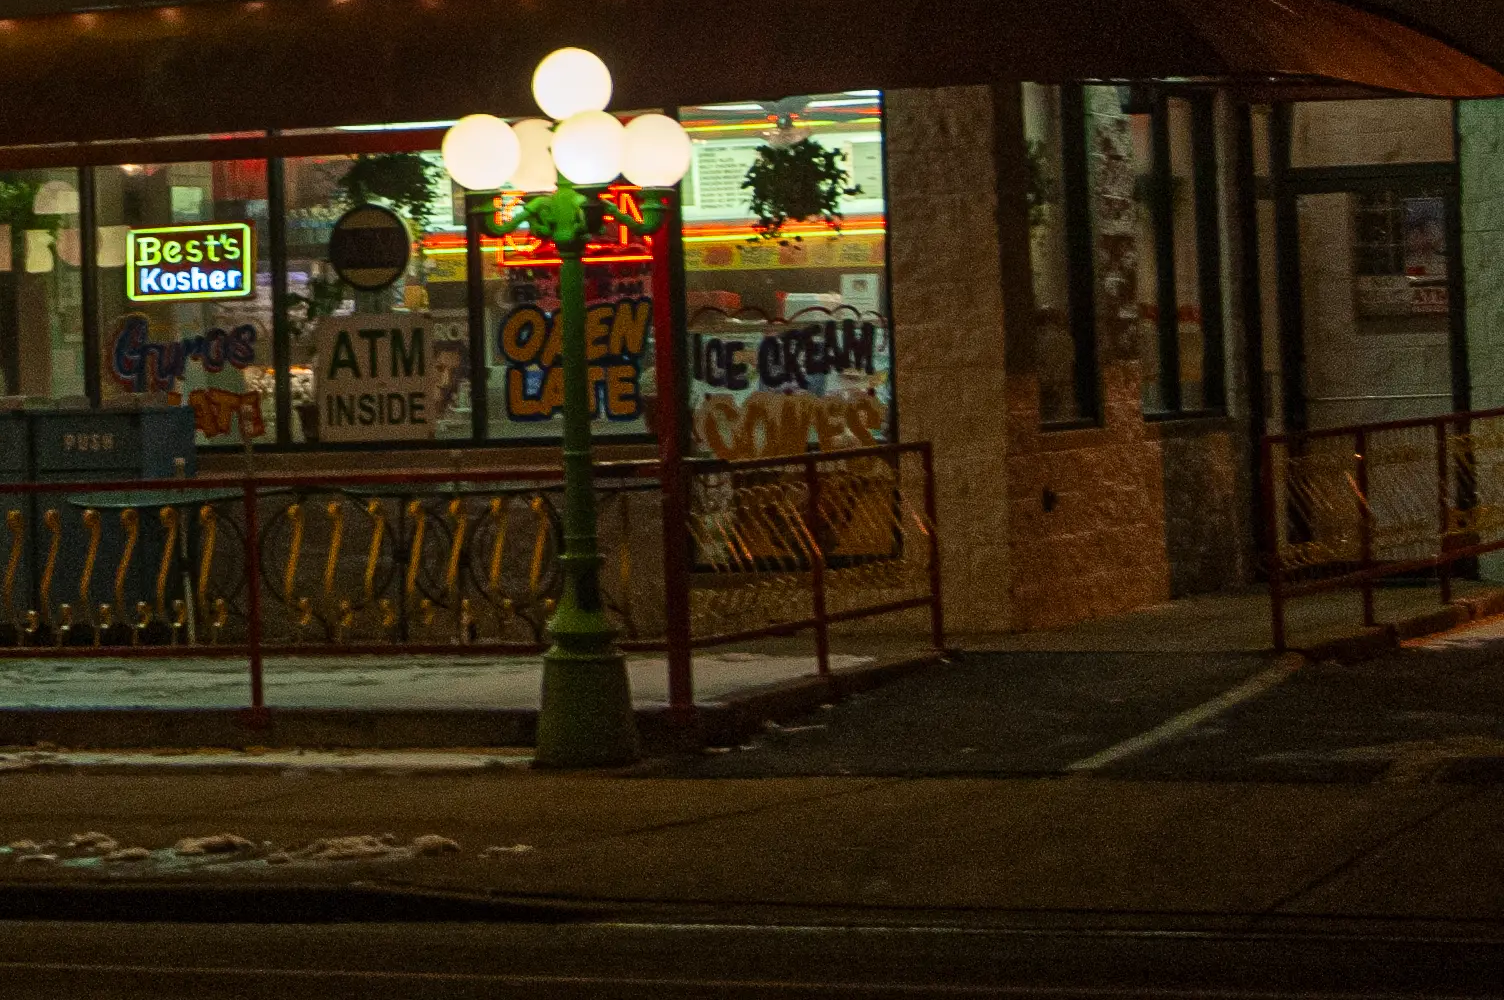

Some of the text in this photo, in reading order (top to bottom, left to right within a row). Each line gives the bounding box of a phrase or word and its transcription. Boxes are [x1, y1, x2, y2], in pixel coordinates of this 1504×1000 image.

[135, 233, 242, 266] Best's
[139, 267, 243, 293] Kosher
[327, 327, 426, 380] ATM
[693, 333, 750, 390] ICE
[326, 392, 428, 425] INSIDE
